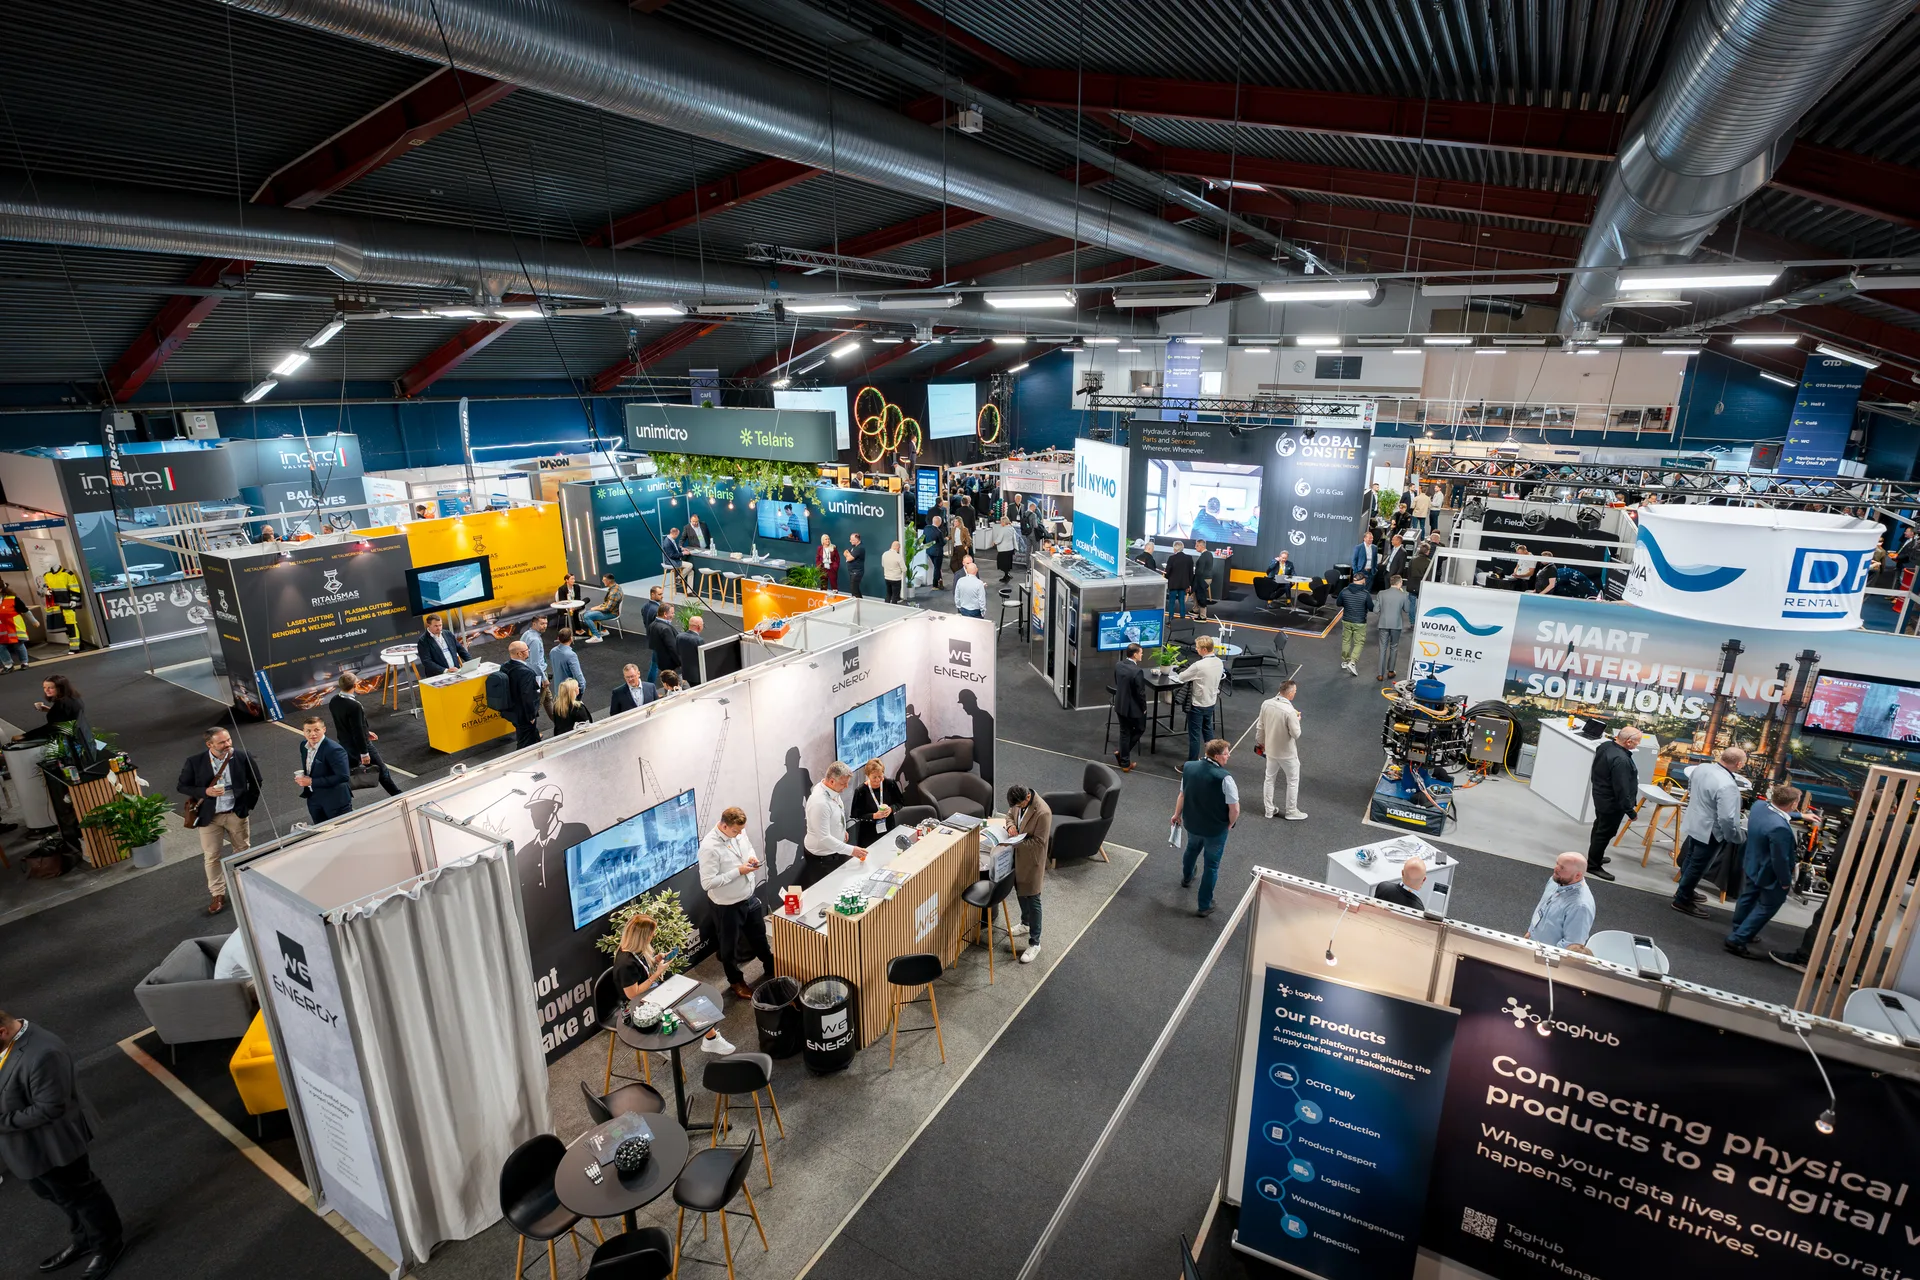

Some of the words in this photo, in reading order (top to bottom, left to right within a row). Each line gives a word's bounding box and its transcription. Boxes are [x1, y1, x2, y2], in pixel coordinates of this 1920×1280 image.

[635, 424, 688, 441] unimicro
[755, 430, 795, 448] Telaris
[1142, 428, 1171, 436] Hydraulic
[105, 424, 122, 470] Recab
[1300, 435, 1362, 449] GLOBAL
[1301, 446, 1356, 460] ONSITE
[607, 487, 634, 497] Telaris
[704, 485, 735, 501] Telaris
[1089, 472, 1117, 499] NYMO
[1315, 487, 1325, 495] Oil
[1331, 488, 1344, 496] Gas
[828, 500, 885, 518] unimicro
[1313, 512, 1326, 520] Fish
[1326, 512, 1353, 522] Farming
[1310, 535, 1328, 543] Wind
[243, 563, 281, 573] METALWORKING
[289, 556, 324, 567] METALWORKING
[370, 544, 401, 553] METALWORKING
[107, 591, 166, 609] TAILOR
[311, 589, 360, 605] RITAUSMAS
[1784, 597, 1840, 608] RENTAL
[110, 603, 158, 619] MADE
[344, 605, 369, 616] PLASMA
[369, 601, 393, 612] CUTTING
[345, 613, 371, 624] DRILLING
[377, 606, 407, 618] THREADING
[272, 628, 301, 639] BENDING
[308, 620, 336, 632] WELDING
[286, 618, 307, 628] LASER
[307, 613, 335, 624] CUTTING
[1421, 621, 1457, 633] WOMA
[1439, 632, 1456, 640] Group
[1536, 620, 1650, 655] SMART
[949, 649, 972, 663] WE
[1445, 646, 1483, 660] DERC
[831, 669, 872, 693] ENERGY
[934, 665, 988, 684] ENERGY
[1533, 646, 1787, 703] WATERJETTING
[1833, 679, 1871, 690] MAGTRACK
[1525, 673, 1711, 722] SOLUTIONS.
[1386, 807, 1428, 822] KÄRCHER
[283, 952, 310, 982] WE
[272, 973, 339, 1029] ENERGY
[541, 1016, 579, 1054] ake
[582, 1006, 596, 1027] a
[1275, 1006, 1306, 1024] Our
[1309, 1015, 1387, 1046] Products
[1272, 1034, 1302, 1049] supply
[1302, 1041, 1332, 1057] chains
[1332, 1050, 1343, 1059] of
[1343, 1052, 1354, 1063] all
[1355, 1057, 1417, 1081] stakeholders.
[1273, 1025, 1281, 1033] A
[1282, 1027, 1319, 1042] modular
[1319, 1036, 1359, 1054] platform
[1359, 1048, 1370, 1057] to
[1371, 1051, 1413, 1071] digitalize
[1414, 1063, 1432, 1076] the
[1305, 1078, 1332, 1092] OCTG
[1333, 1086, 1356, 1101] Tally
[1328, 1116, 1381, 1139] Production
[1490, 1053, 1713, 1146] Connecting
[1722, 1127, 1910, 1208] physical
[1298, 1136, 1335, 1155] Product
[1335, 1149, 1377, 1169] Passport
[1484, 1082, 1651, 1153] products
[1661, 1138, 1702, 1171] to
[1711, 1160, 1737, 1186] a
[1747, 1175, 1892, 1236] digital
[1320, 1174, 1361, 1195] Logistics
[1475, 1140, 1578, 1195] happens,
[1583, 1183, 1630, 1212] and
[1633, 1202, 1662, 1226] AI
[1667, 1213, 1761, 1260] thrives.
[1480, 1121, 1555, 1162] Where
[1557, 1149, 1615, 1183] your
[1618, 1172, 1675, 1206] data
[1681, 1193, 1743, 1232] lives,
[1749, 1223, 1914, 1280] collaborati
[1291, 1192, 1342, 1218] Warehouse
[1342, 1211, 1405, 1242] Management
[1312, 1230, 1361, 1255] Inspection
[1506, 1222, 1565, 1254] TagHub
[1503, 1238, 1548, 1266] Smart
